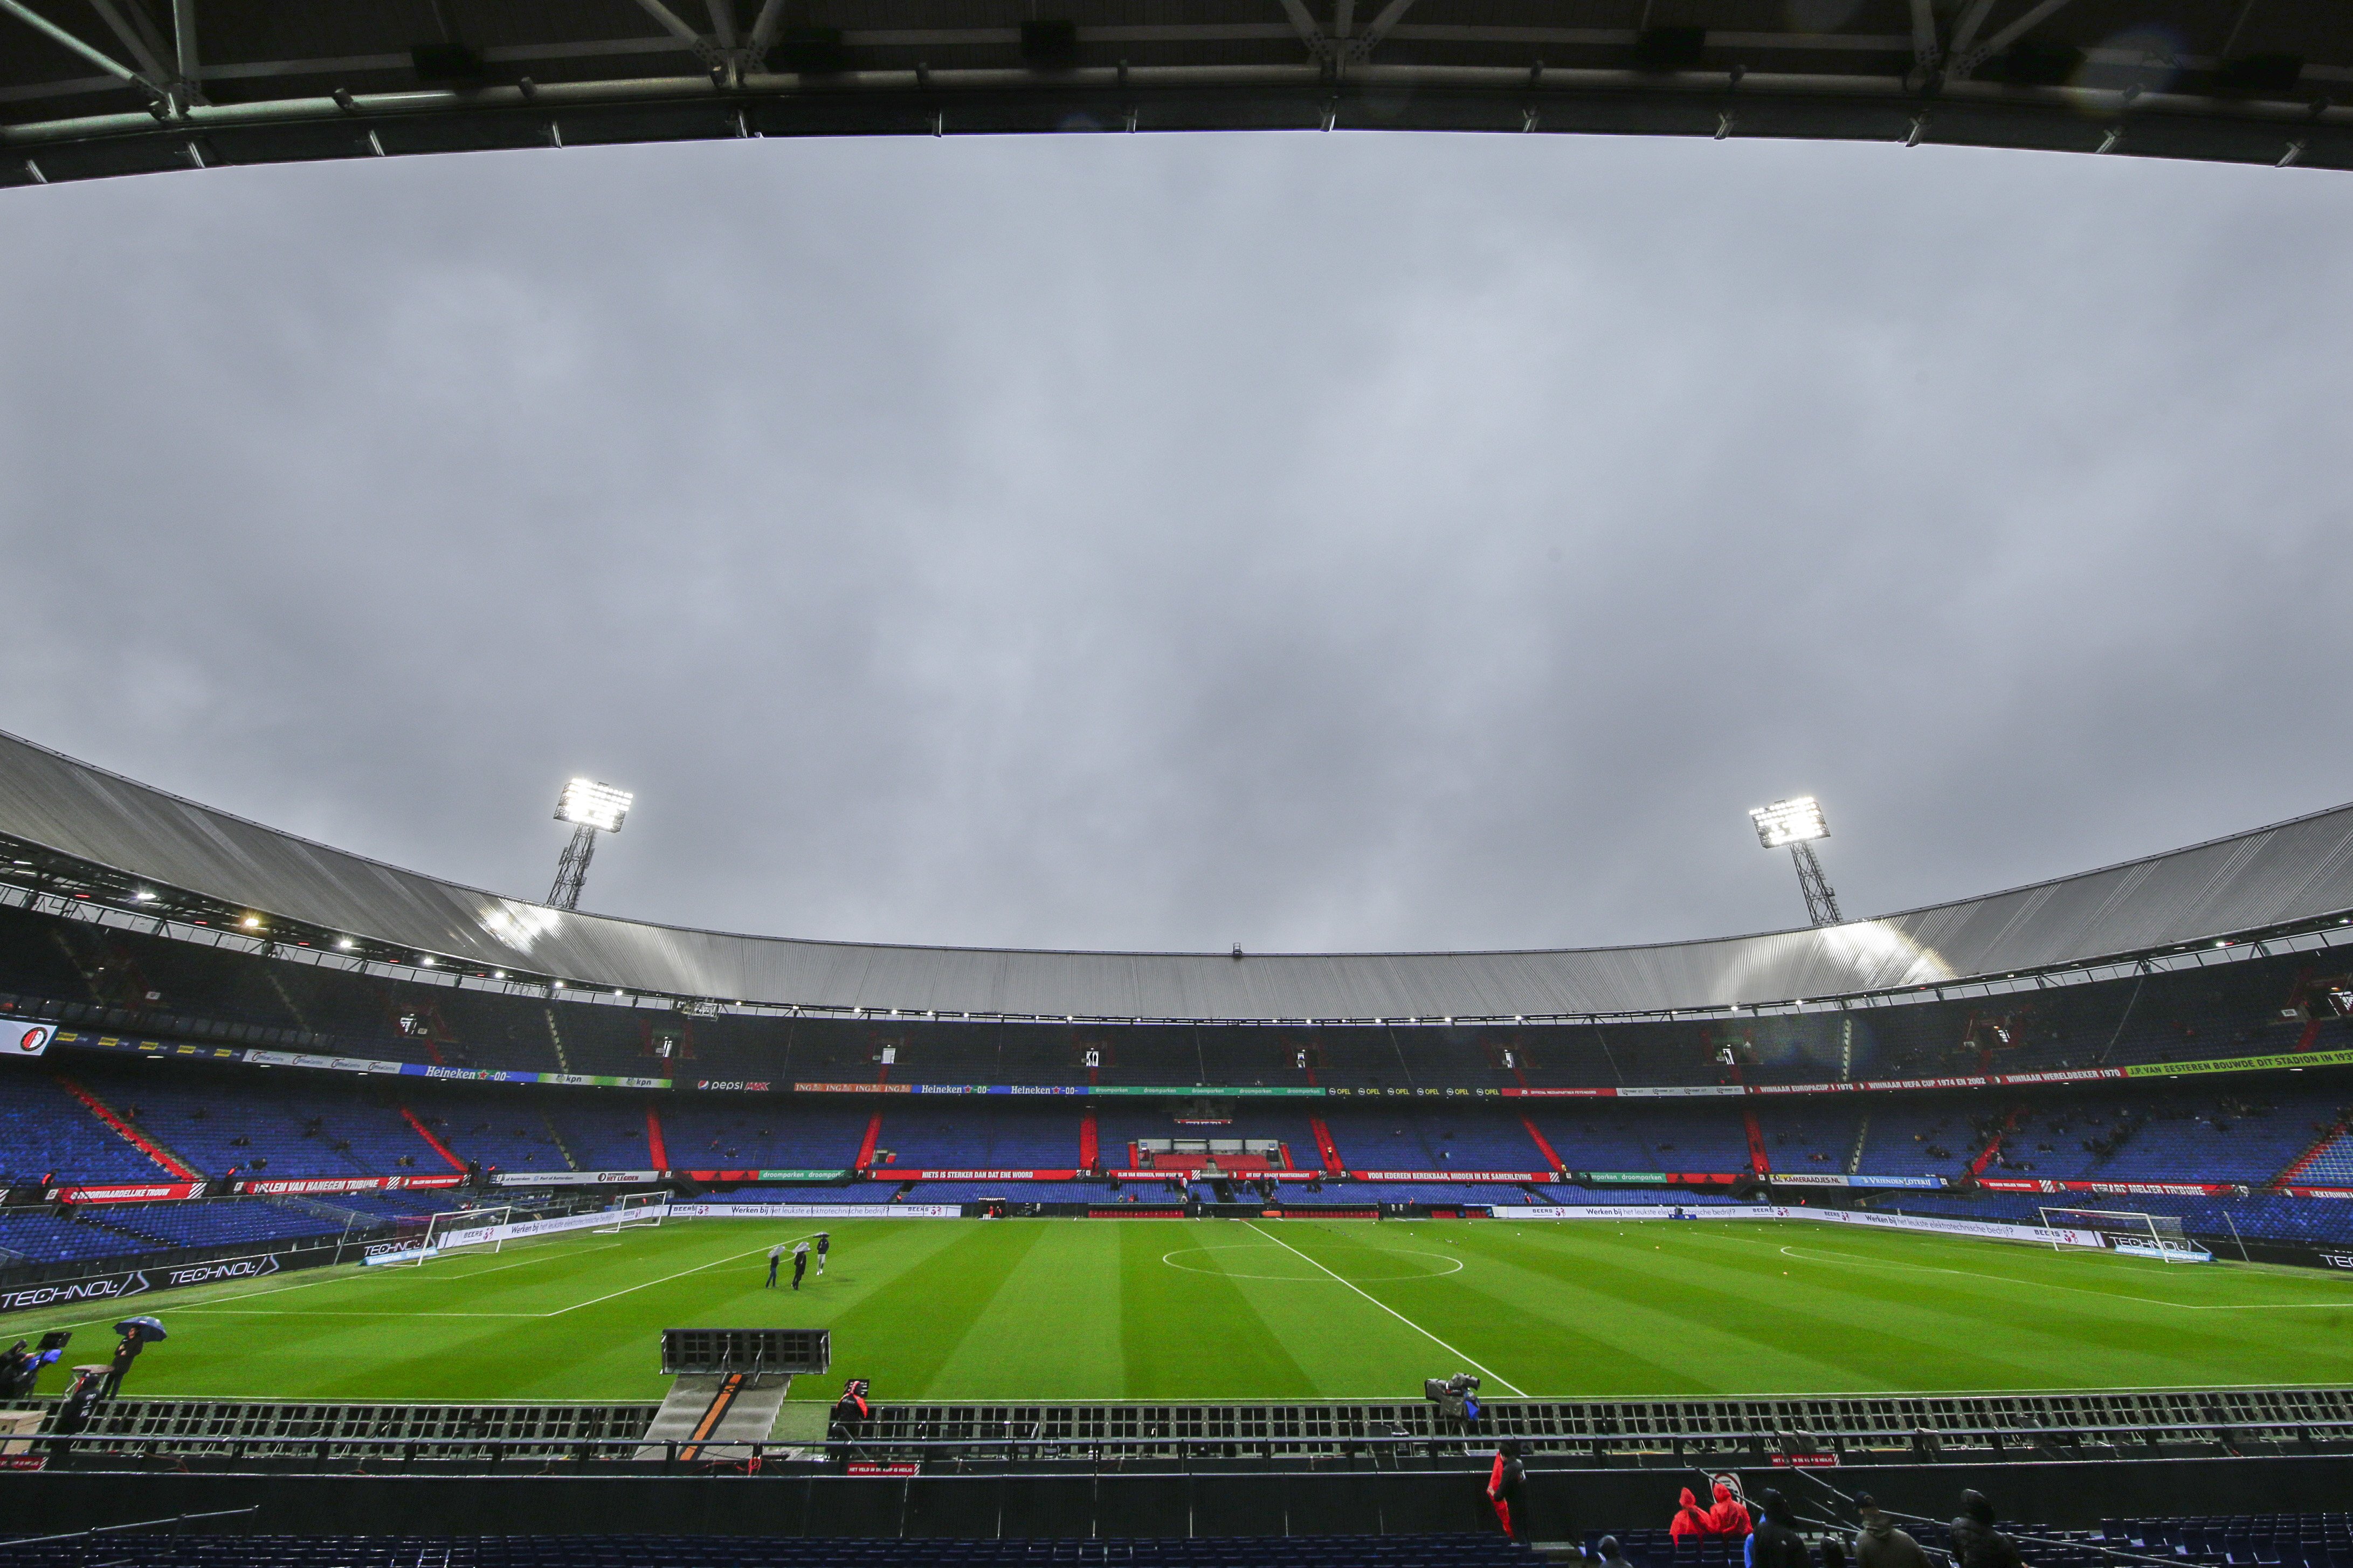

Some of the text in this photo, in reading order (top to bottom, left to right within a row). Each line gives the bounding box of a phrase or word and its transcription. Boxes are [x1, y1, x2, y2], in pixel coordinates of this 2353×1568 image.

[2164, 1063, 2211, 1072] EESTEREN
[2212, 1059, 2253, 1069] BOUWDE
[2257, 1058, 2273, 1067] DIT
[2274, 1055, 2319, 1065] STADION
[2320, 1054, 2334, 1062] IN
[2335, 1052, 2353, 1061] 193
[425, 1066, 476, 1080] Heineken
[2006, 1069, 2121, 1083] WINNAAR WERELDBEKER 1970
[711, 1081, 743, 1090] pepsi
[921, 1085, 962, 1093] Heineken
[1868, 1081, 1902, 1089] WINNAAR
[1011, 1086, 1051, 1094] Heineken
[1412, 1172, 1450, 1181] BEREIKBAAR,
[1784, 1175, 1841, 1184] KAMERAADJES.NL
[287, 1182, 306, 1192] VAN
[306, 1180, 346, 1191] HANEGEM
[760, 1206, 769, 1215] bij
[1713, 1208, 1736, 1217] bedrijf?
[1865, 1214, 1888, 1224] Werken
[1889, 1216, 1897, 1226] bij
[511, 1224, 532, 1234] Werken
[464, 1231, 483, 1239] BEERS
